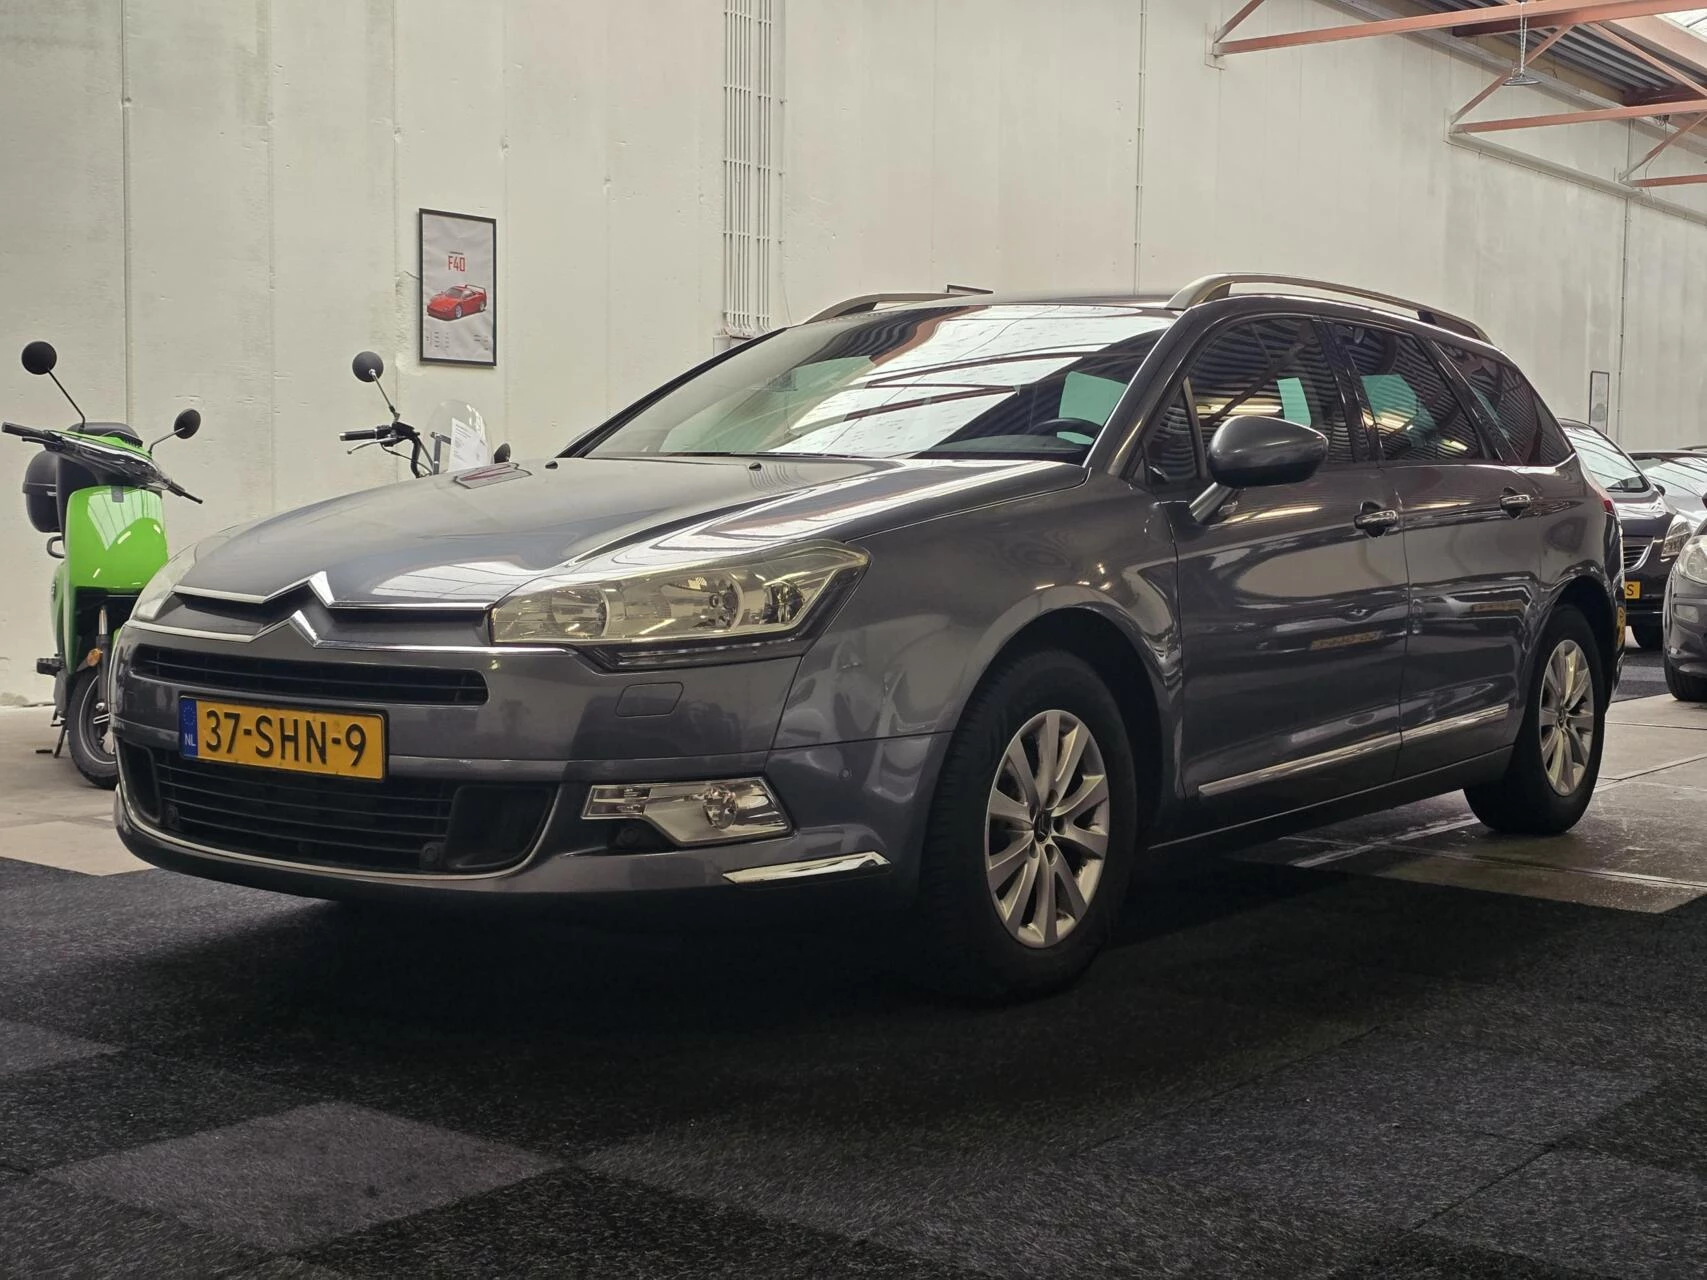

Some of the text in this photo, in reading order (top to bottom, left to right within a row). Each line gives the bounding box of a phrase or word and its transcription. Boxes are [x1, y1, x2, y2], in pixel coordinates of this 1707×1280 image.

[448, 255, 466, 272] F40
[184, 733, 197, 747] NL
[206, 709, 367, 767] 37-SHN-9
